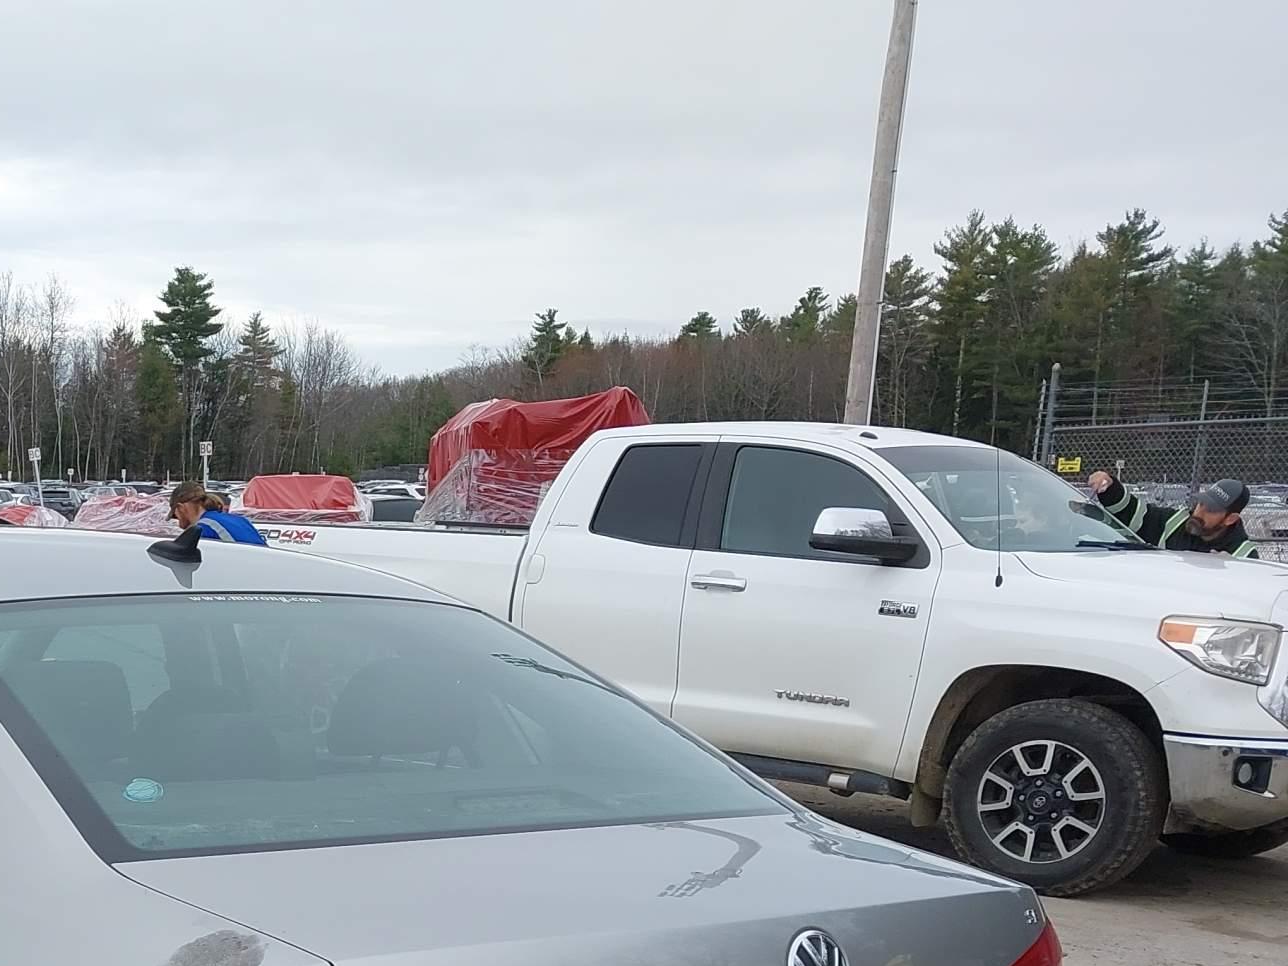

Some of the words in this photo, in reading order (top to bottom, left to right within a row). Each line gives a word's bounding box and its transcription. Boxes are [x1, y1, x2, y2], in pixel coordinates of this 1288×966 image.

[200, 443, 212, 454] BC
[189, 595, 321, 604] www.morong.com
[774, 689, 850, 708] TUNDRA
